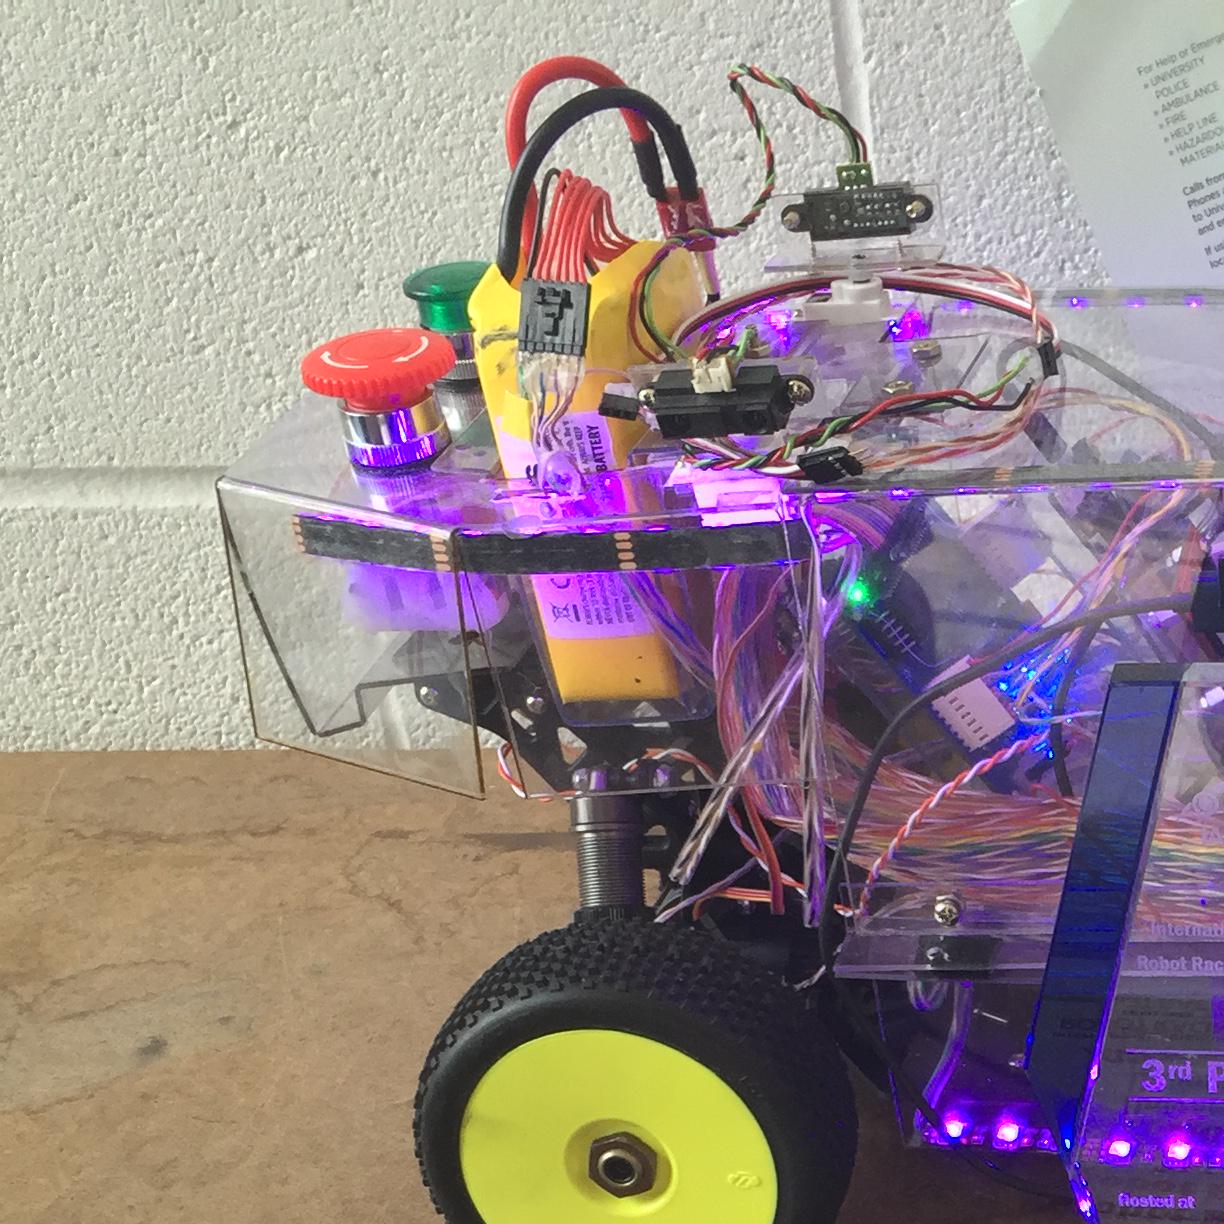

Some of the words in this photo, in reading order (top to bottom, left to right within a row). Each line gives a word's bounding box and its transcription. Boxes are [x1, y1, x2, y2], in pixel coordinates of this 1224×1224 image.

[1136, 64, 1153, 77] For
[1155, 53, 1178, 69] Help
[1150, 55, 1206, 87] UNIVERSITY
[1154, 78, 1191, 100] POLICE
[1160, 80, 1221, 114] AMBULANCE
[1164, 110, 1188, 128] FIRE
[1169, 121, 1195, 140] HELP
[1198, 112, 1219, 130] LINE
[1182, 180, 1205, 197] Calls
[1187, 190, 1221, 210] Phones
[1192, 212, 1204, 223] to
[1197, 222, 1215, 236] and
[1204, 245, 1212, 256] If
[586, 424, 608, 472] BATTERY
[1137, 955, 1188, 972] Robot
[1140, 1058, 1193, 1092] 3rd
[1118, 1191, 1175, 1209] Hosted
[1177, 1195, 1197, 1210] at
